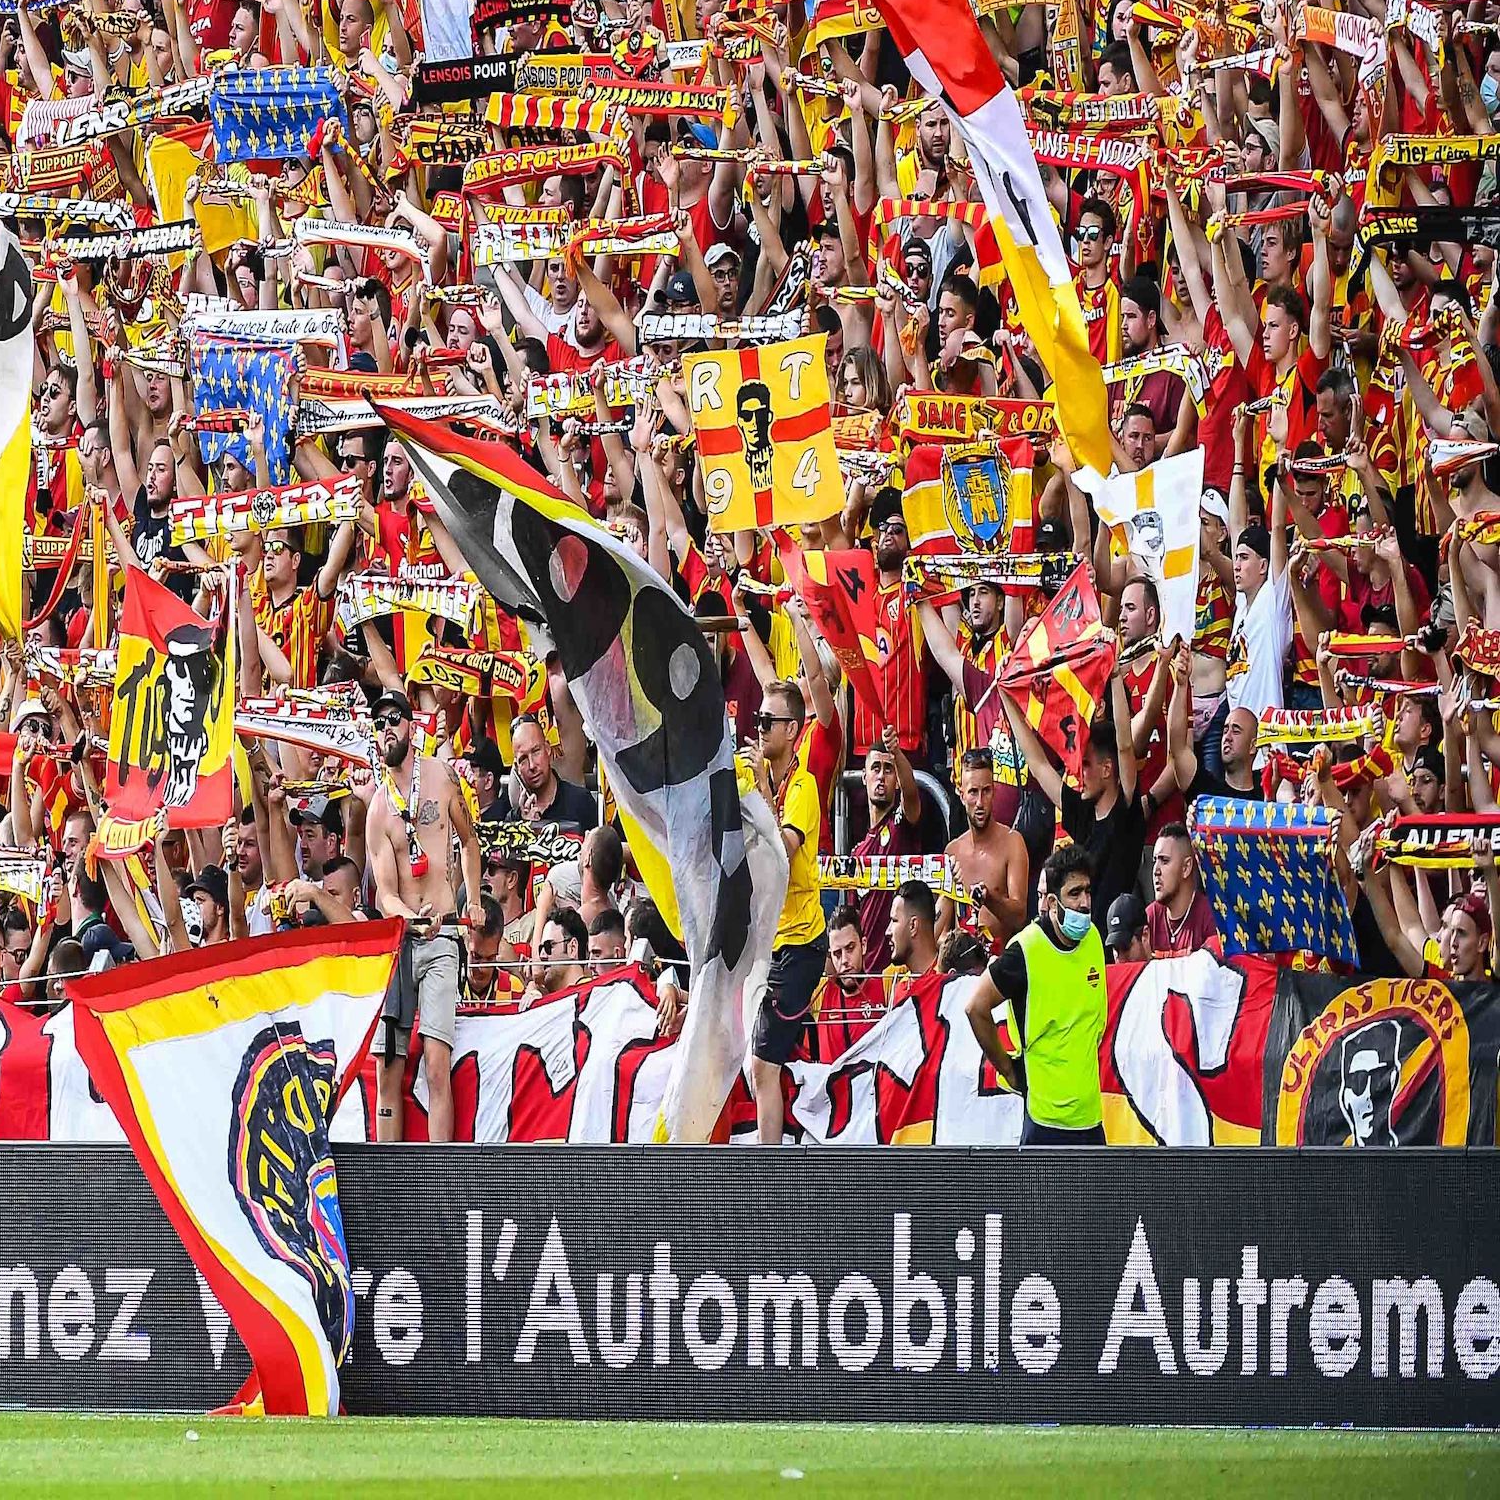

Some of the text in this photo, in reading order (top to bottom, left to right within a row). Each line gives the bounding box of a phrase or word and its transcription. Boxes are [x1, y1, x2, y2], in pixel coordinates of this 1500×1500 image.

[422, 63, 506, 85] LENSOIS POUR
[1073, 137, 1141, 170] ET NORD
[1397, 141, 1471, 163] Fier d'être
[133, 220, 194, 253] MERDA
[691, 351, 813, 412] R T
[917, 400, 966, 434] SANG
[706, 447, 821, 513] 9 4
[466, 1209, 1062, 1377] l'Automobile
[1098, 1214, 1500, 1379] Autreme
